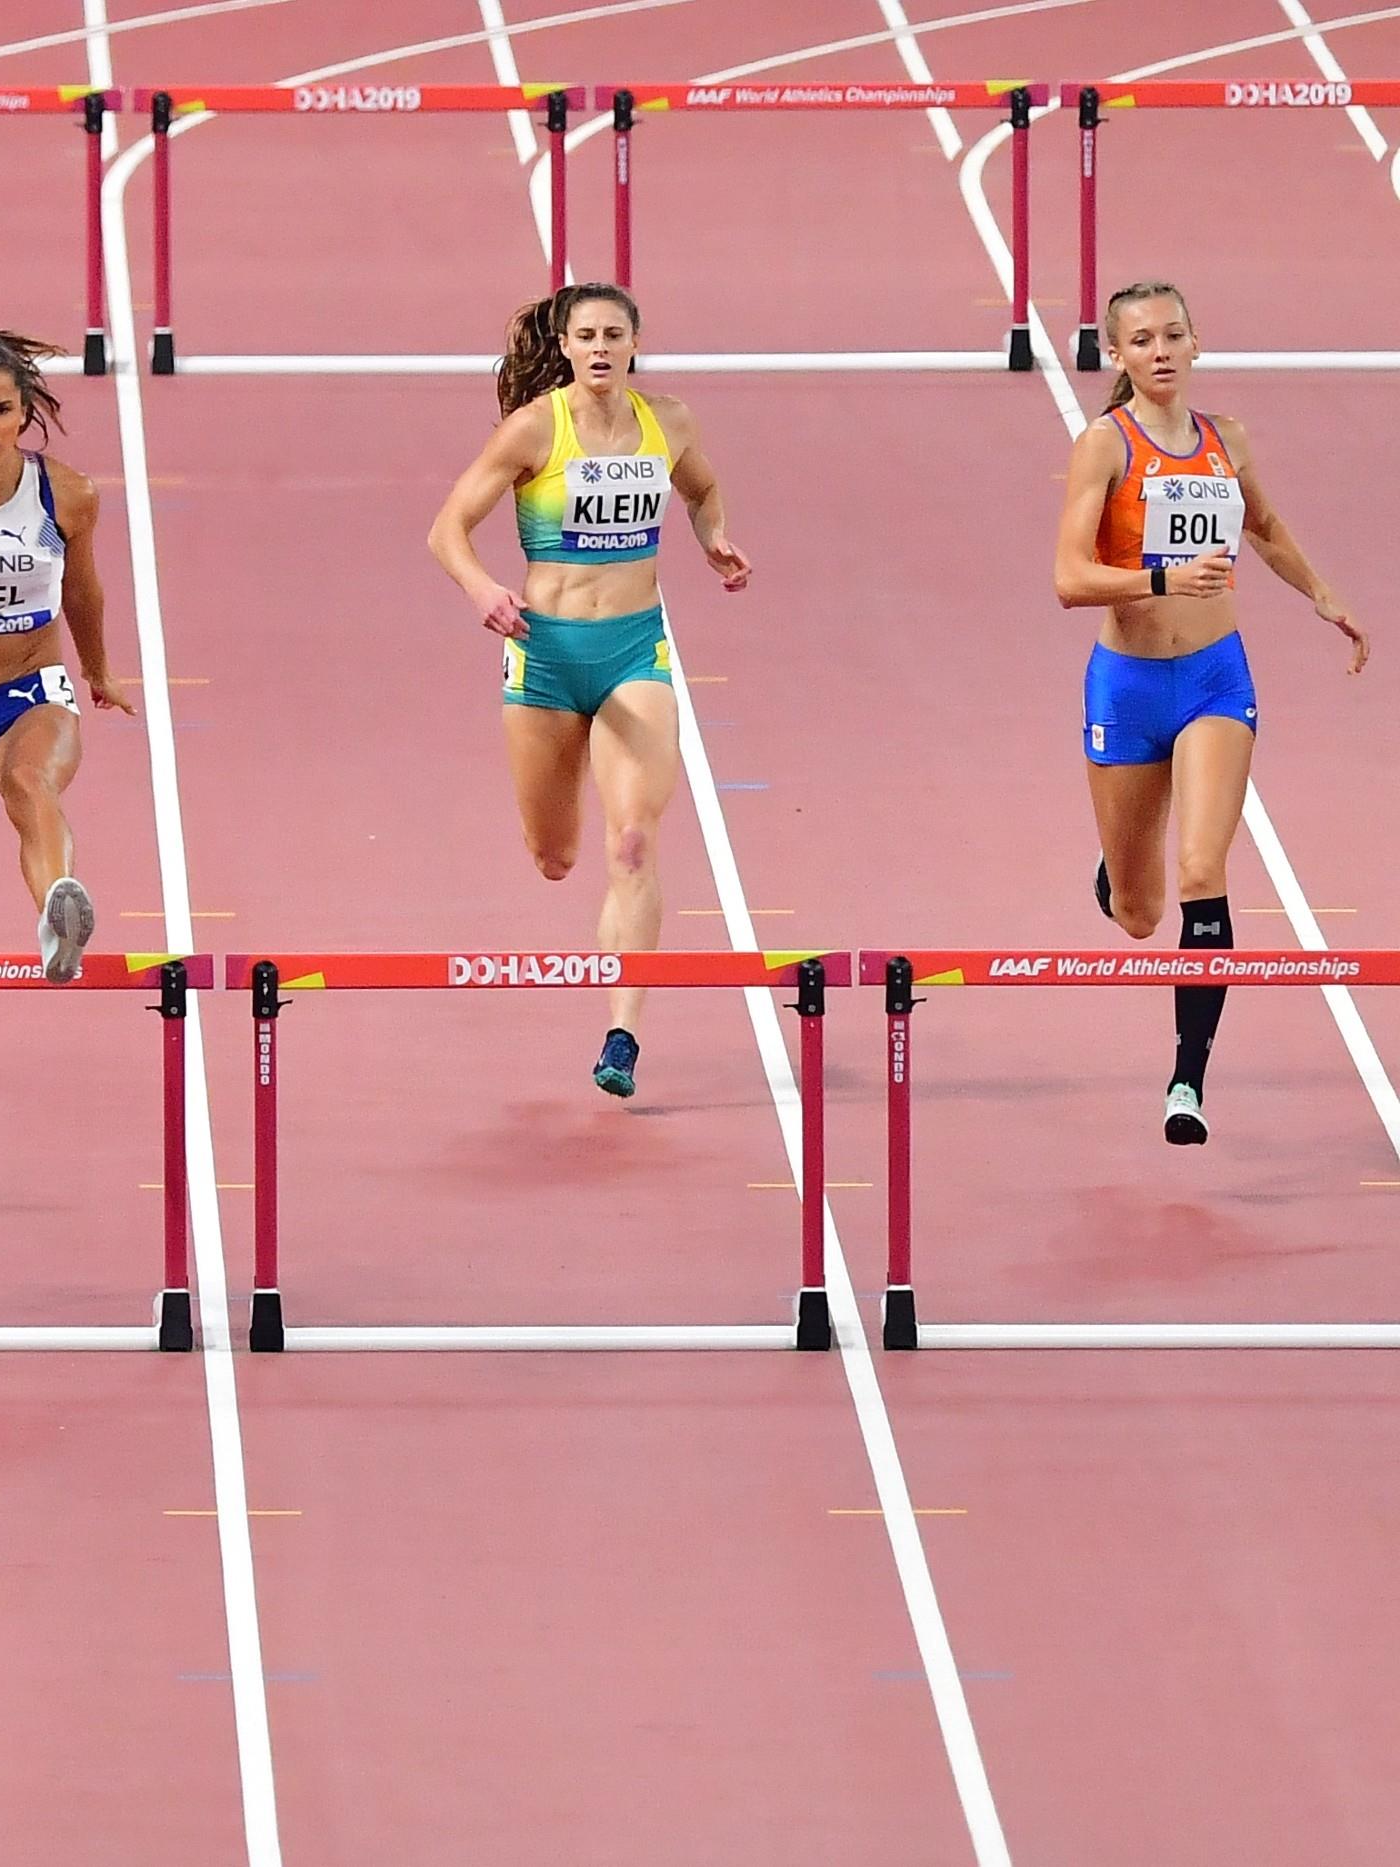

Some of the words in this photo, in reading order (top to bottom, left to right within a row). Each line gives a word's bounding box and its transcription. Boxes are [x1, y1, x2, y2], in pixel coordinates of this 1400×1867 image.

[294, 87, 421, 111] DOHA2019
[686, 88, 732, 104] IAAF
[735, 88, 780, 104] World
[780, 87, 842, 103] Athletics
[845, 86, 956, 105] Championships
[1224, 83, 1352, 106] DOHA2019
[607, 462, 654, 480] QNB
[1188, 481, 1230, 499] QNB
[573, 493, 661, 524] KLEIN
[1169, 513, 1226, 544] BOL
[577, 532, 648, 549] DOHA2019
[448, 954, 622, 985] DOHA2019
[989, 957, 1052, 976] IAAF
[1057, 957, 1116, 976] World
[1119, 956, 1204, 976] Athletics
[1209, 956, 1360, 979] Championships
